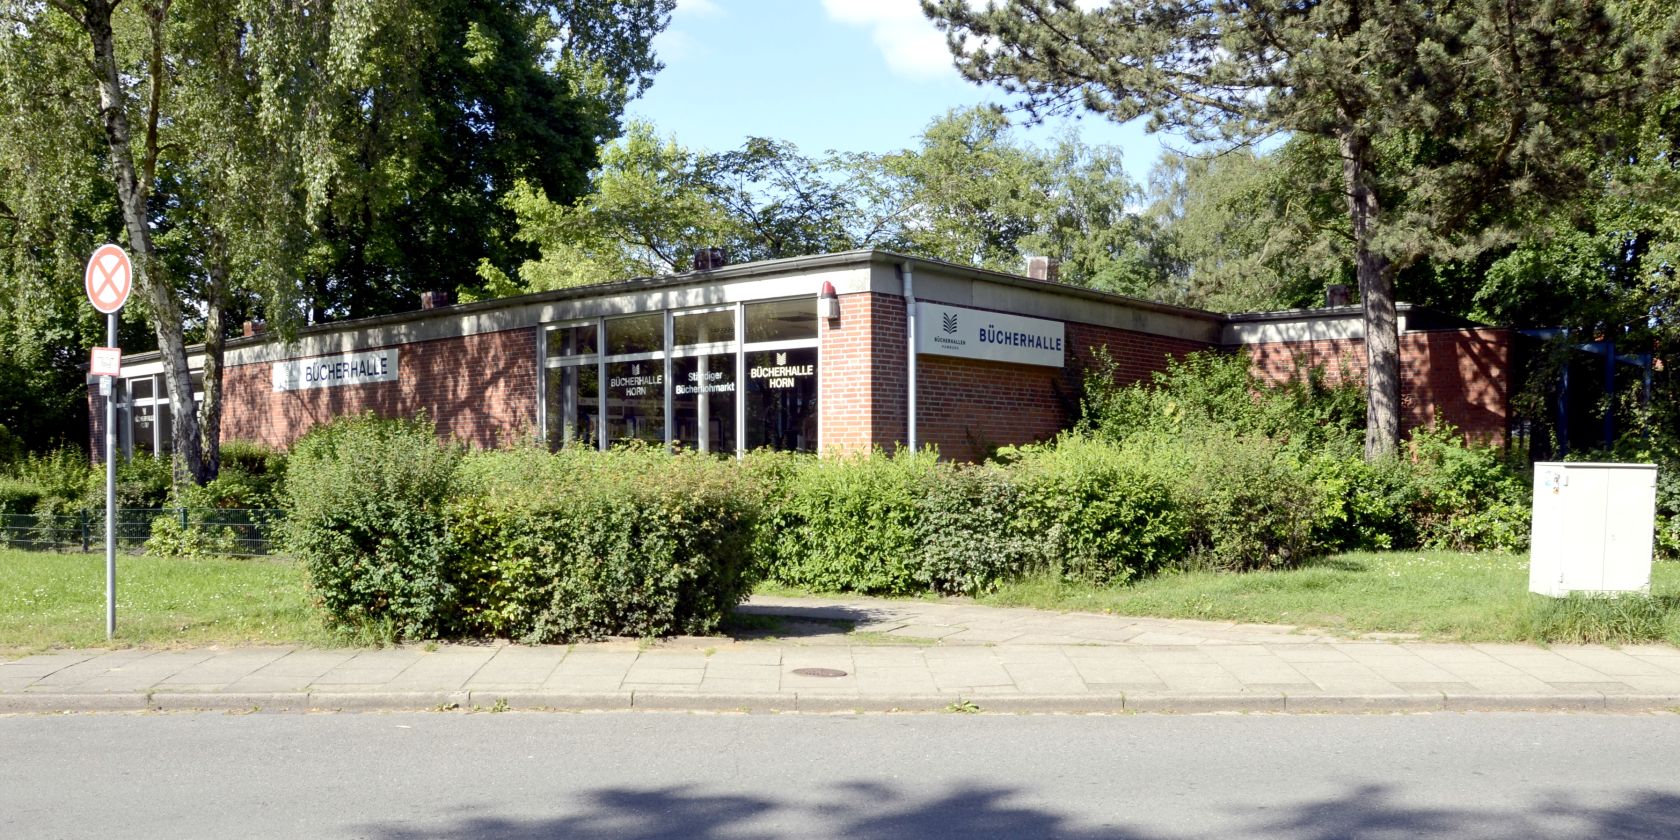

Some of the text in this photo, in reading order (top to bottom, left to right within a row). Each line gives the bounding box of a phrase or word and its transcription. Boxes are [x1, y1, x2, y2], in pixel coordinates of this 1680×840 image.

[979, 324, 1062, 351] BÜCHERHALLE
[305, 358, 388, 382] BÜCHERHALLE
[751, 364, 813, 378] BÜCHERHALLE
[610, 375, 662, 387] BÜCHERHALLE
[769, 377, 794, 388] HORN
[626, 387, 646, 396] HORN
